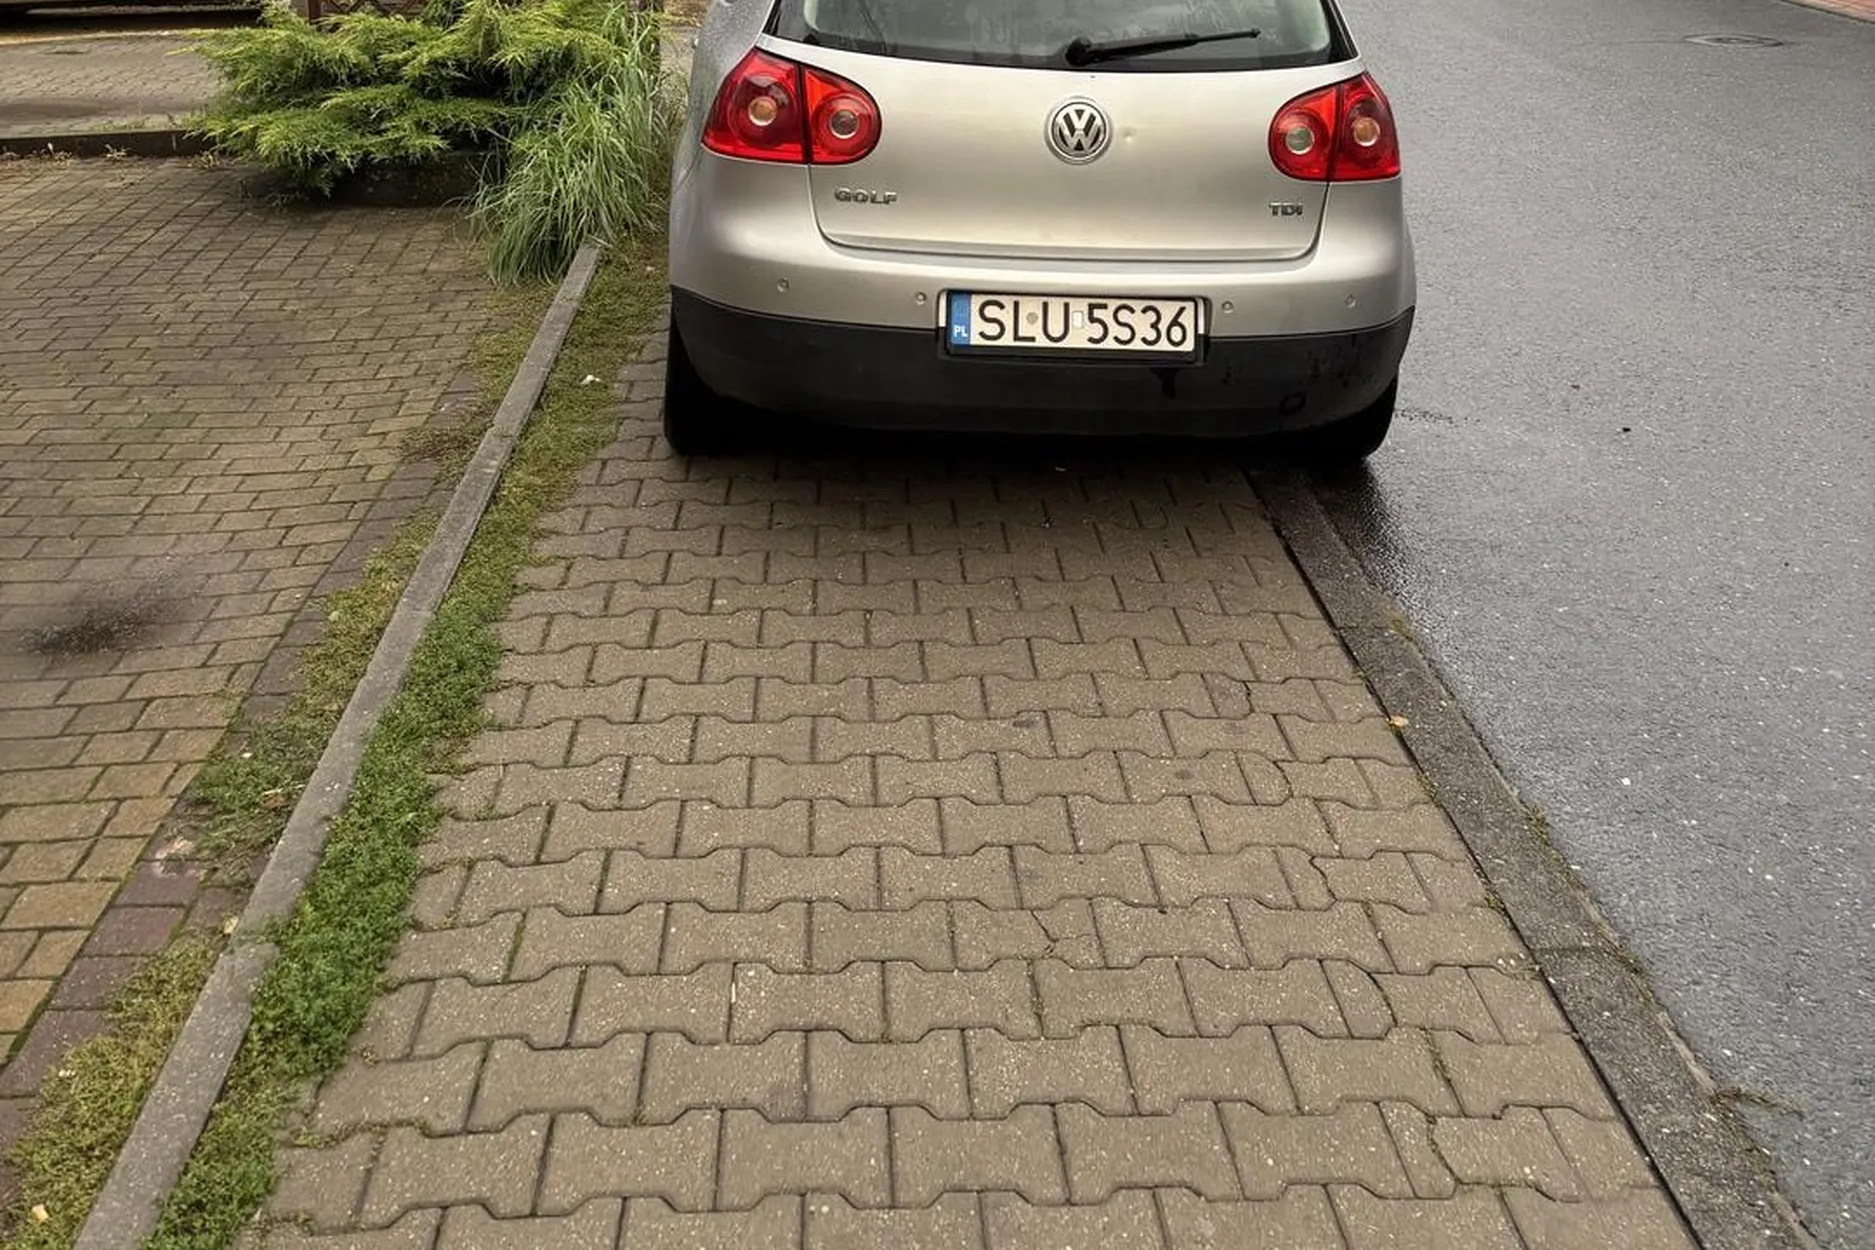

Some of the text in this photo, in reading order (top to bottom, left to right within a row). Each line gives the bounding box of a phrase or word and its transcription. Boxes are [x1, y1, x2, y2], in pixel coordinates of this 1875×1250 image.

[1051, 102, 1107, 159] VW
[834, 187, 898, 205] GOLF
[1269, 201, 1304, 217] TDI
[953, 324, 969, 338] PL
